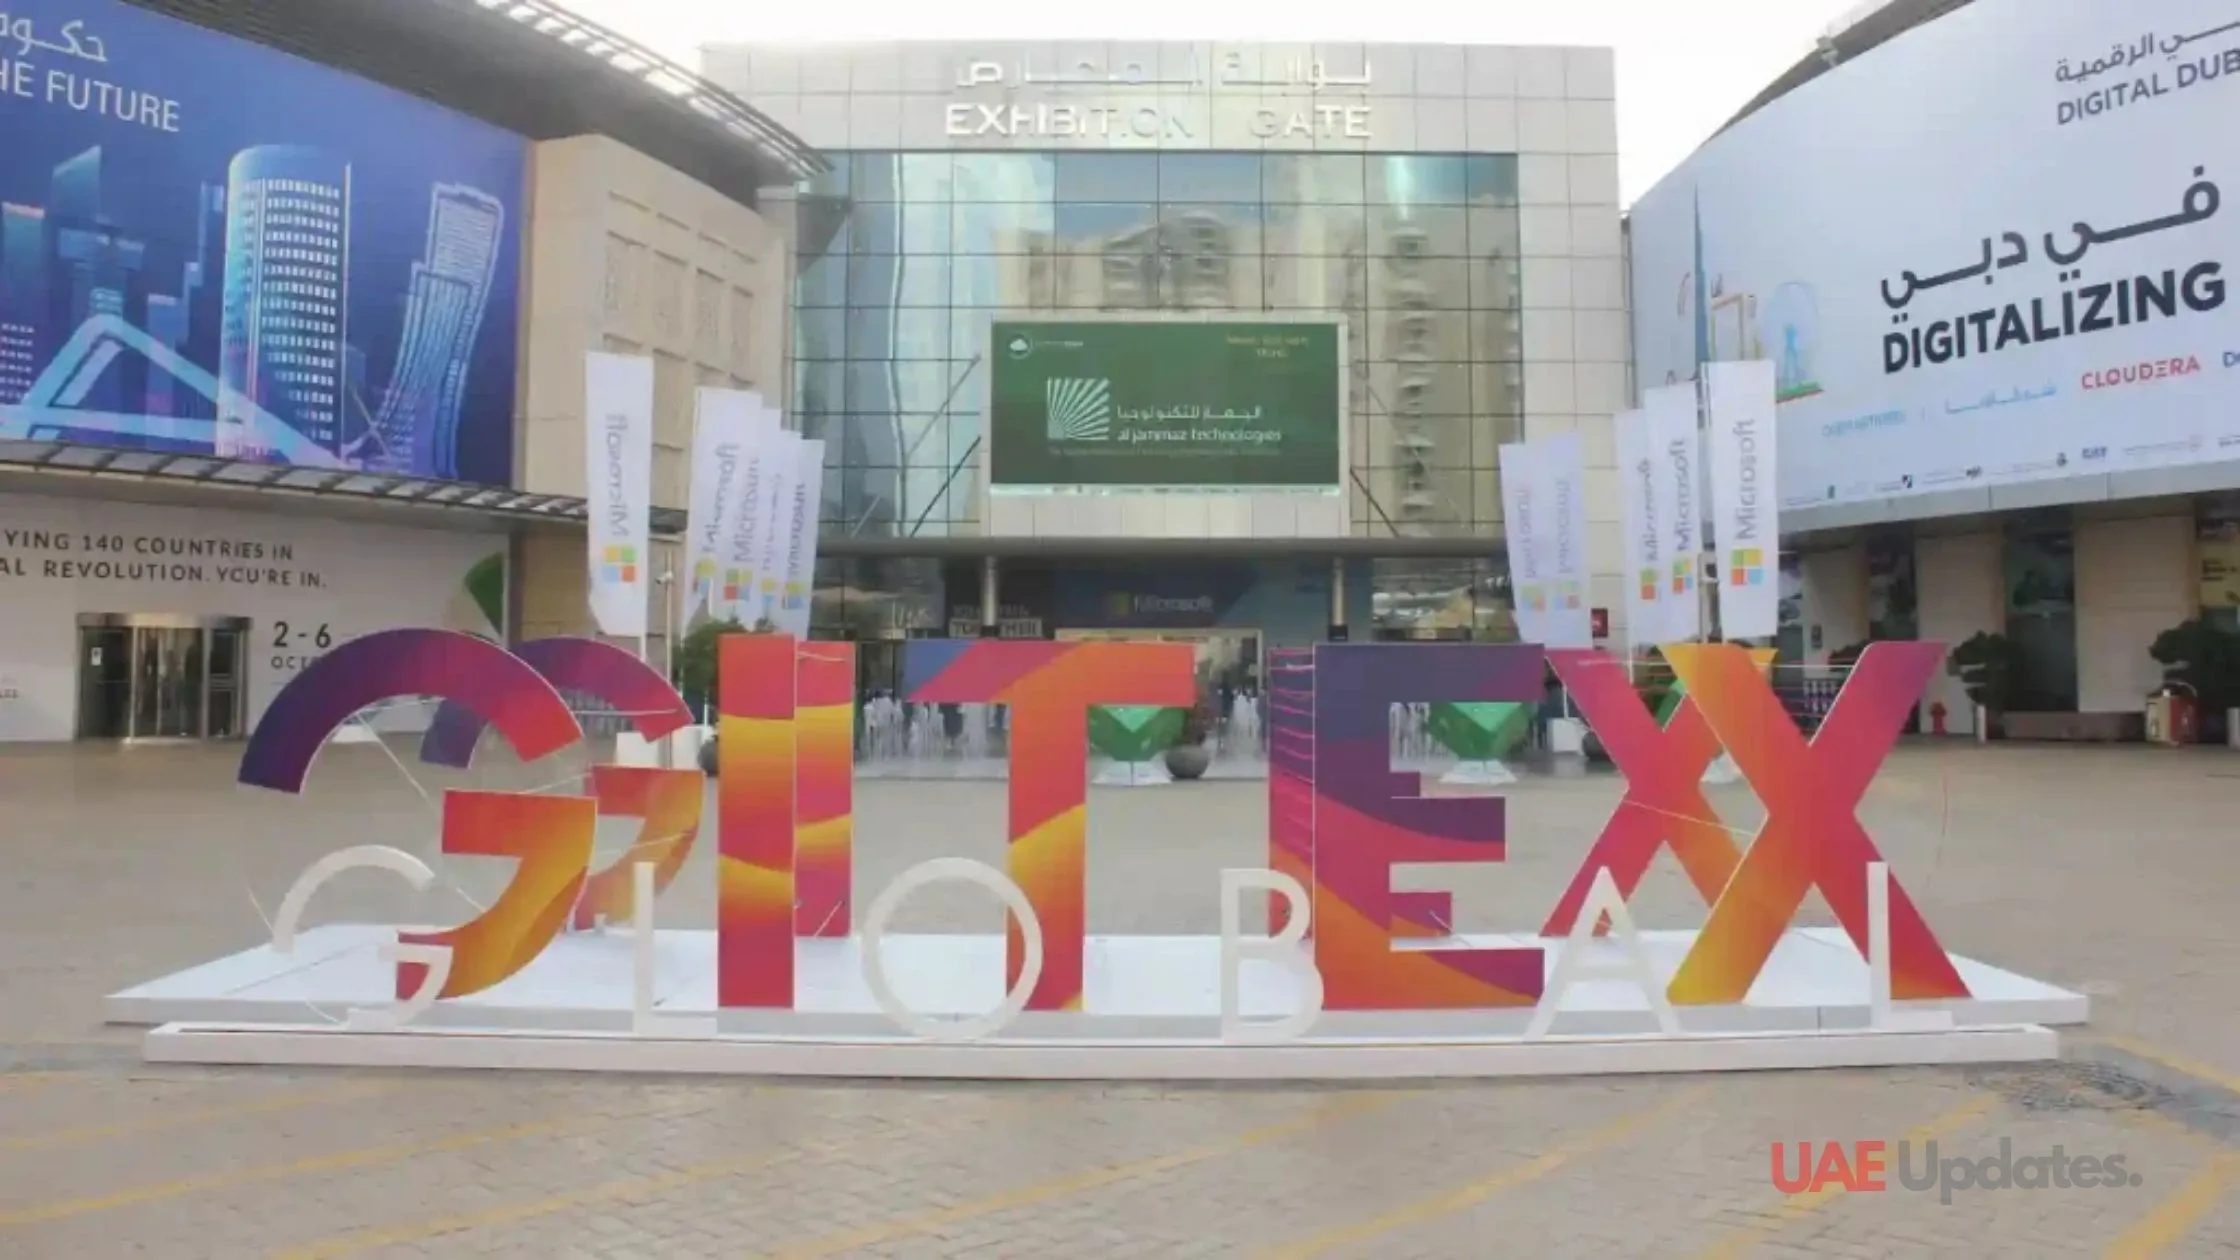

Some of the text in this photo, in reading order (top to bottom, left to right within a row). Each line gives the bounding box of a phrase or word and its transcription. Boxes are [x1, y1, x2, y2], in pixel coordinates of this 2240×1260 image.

[2055, 31, 2154, 82] الرقمية
[47, 69, 180, 132] FUTURE
[945, 101, 1372, 139] EXHIBITON GATE
[2056, 71, 2170, 125] DIGITAL
[1881, 164, 2220, 325] في دبي
[1883, 261, 2225, 375] DIGITALIZING
[2081, 355, 2201, 389] CLOUDERA
[1191, 426, 1281, 444] technologies
[1668, 438, 1693, 551] Microsoft
[1732, 419, 1758, 541] Microsoft
[5, 529, 293, 561] YING 140 COUNTRIES IN
[43, 559, 210, 582] REVOLUTION.
[300, 570, 327, 588] IN.
[272, 620, 290, 648] 2
[314, 620, 333, 649] 6
[237, 628, 1973, 1012] GITEX
[268, 844, 1954, 1044] GLOBAL
